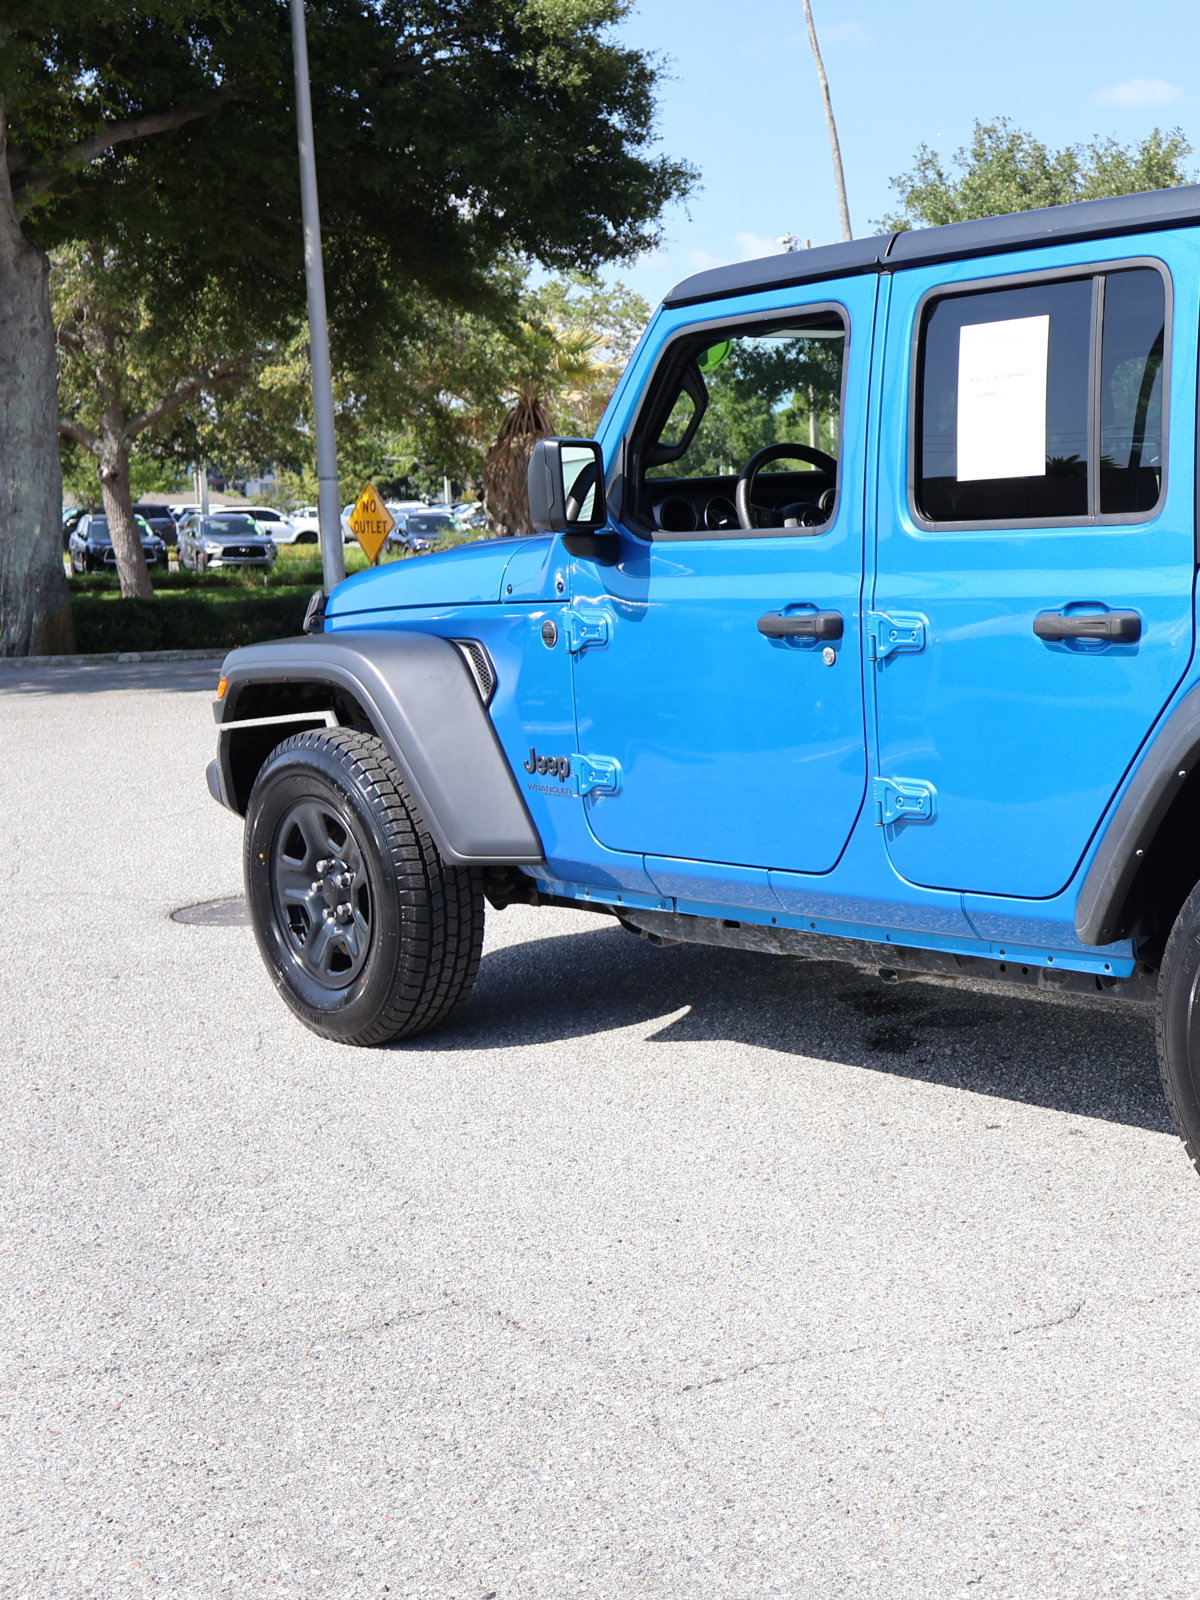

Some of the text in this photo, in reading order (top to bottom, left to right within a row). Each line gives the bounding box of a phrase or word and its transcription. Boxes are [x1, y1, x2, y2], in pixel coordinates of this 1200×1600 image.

[362, 500, 376, 513] NO
[353, 520, 388, 534] OUTLET
[523, 746, 571, 783] Jeep
[527, 783, 573, 794] WRANGLER
